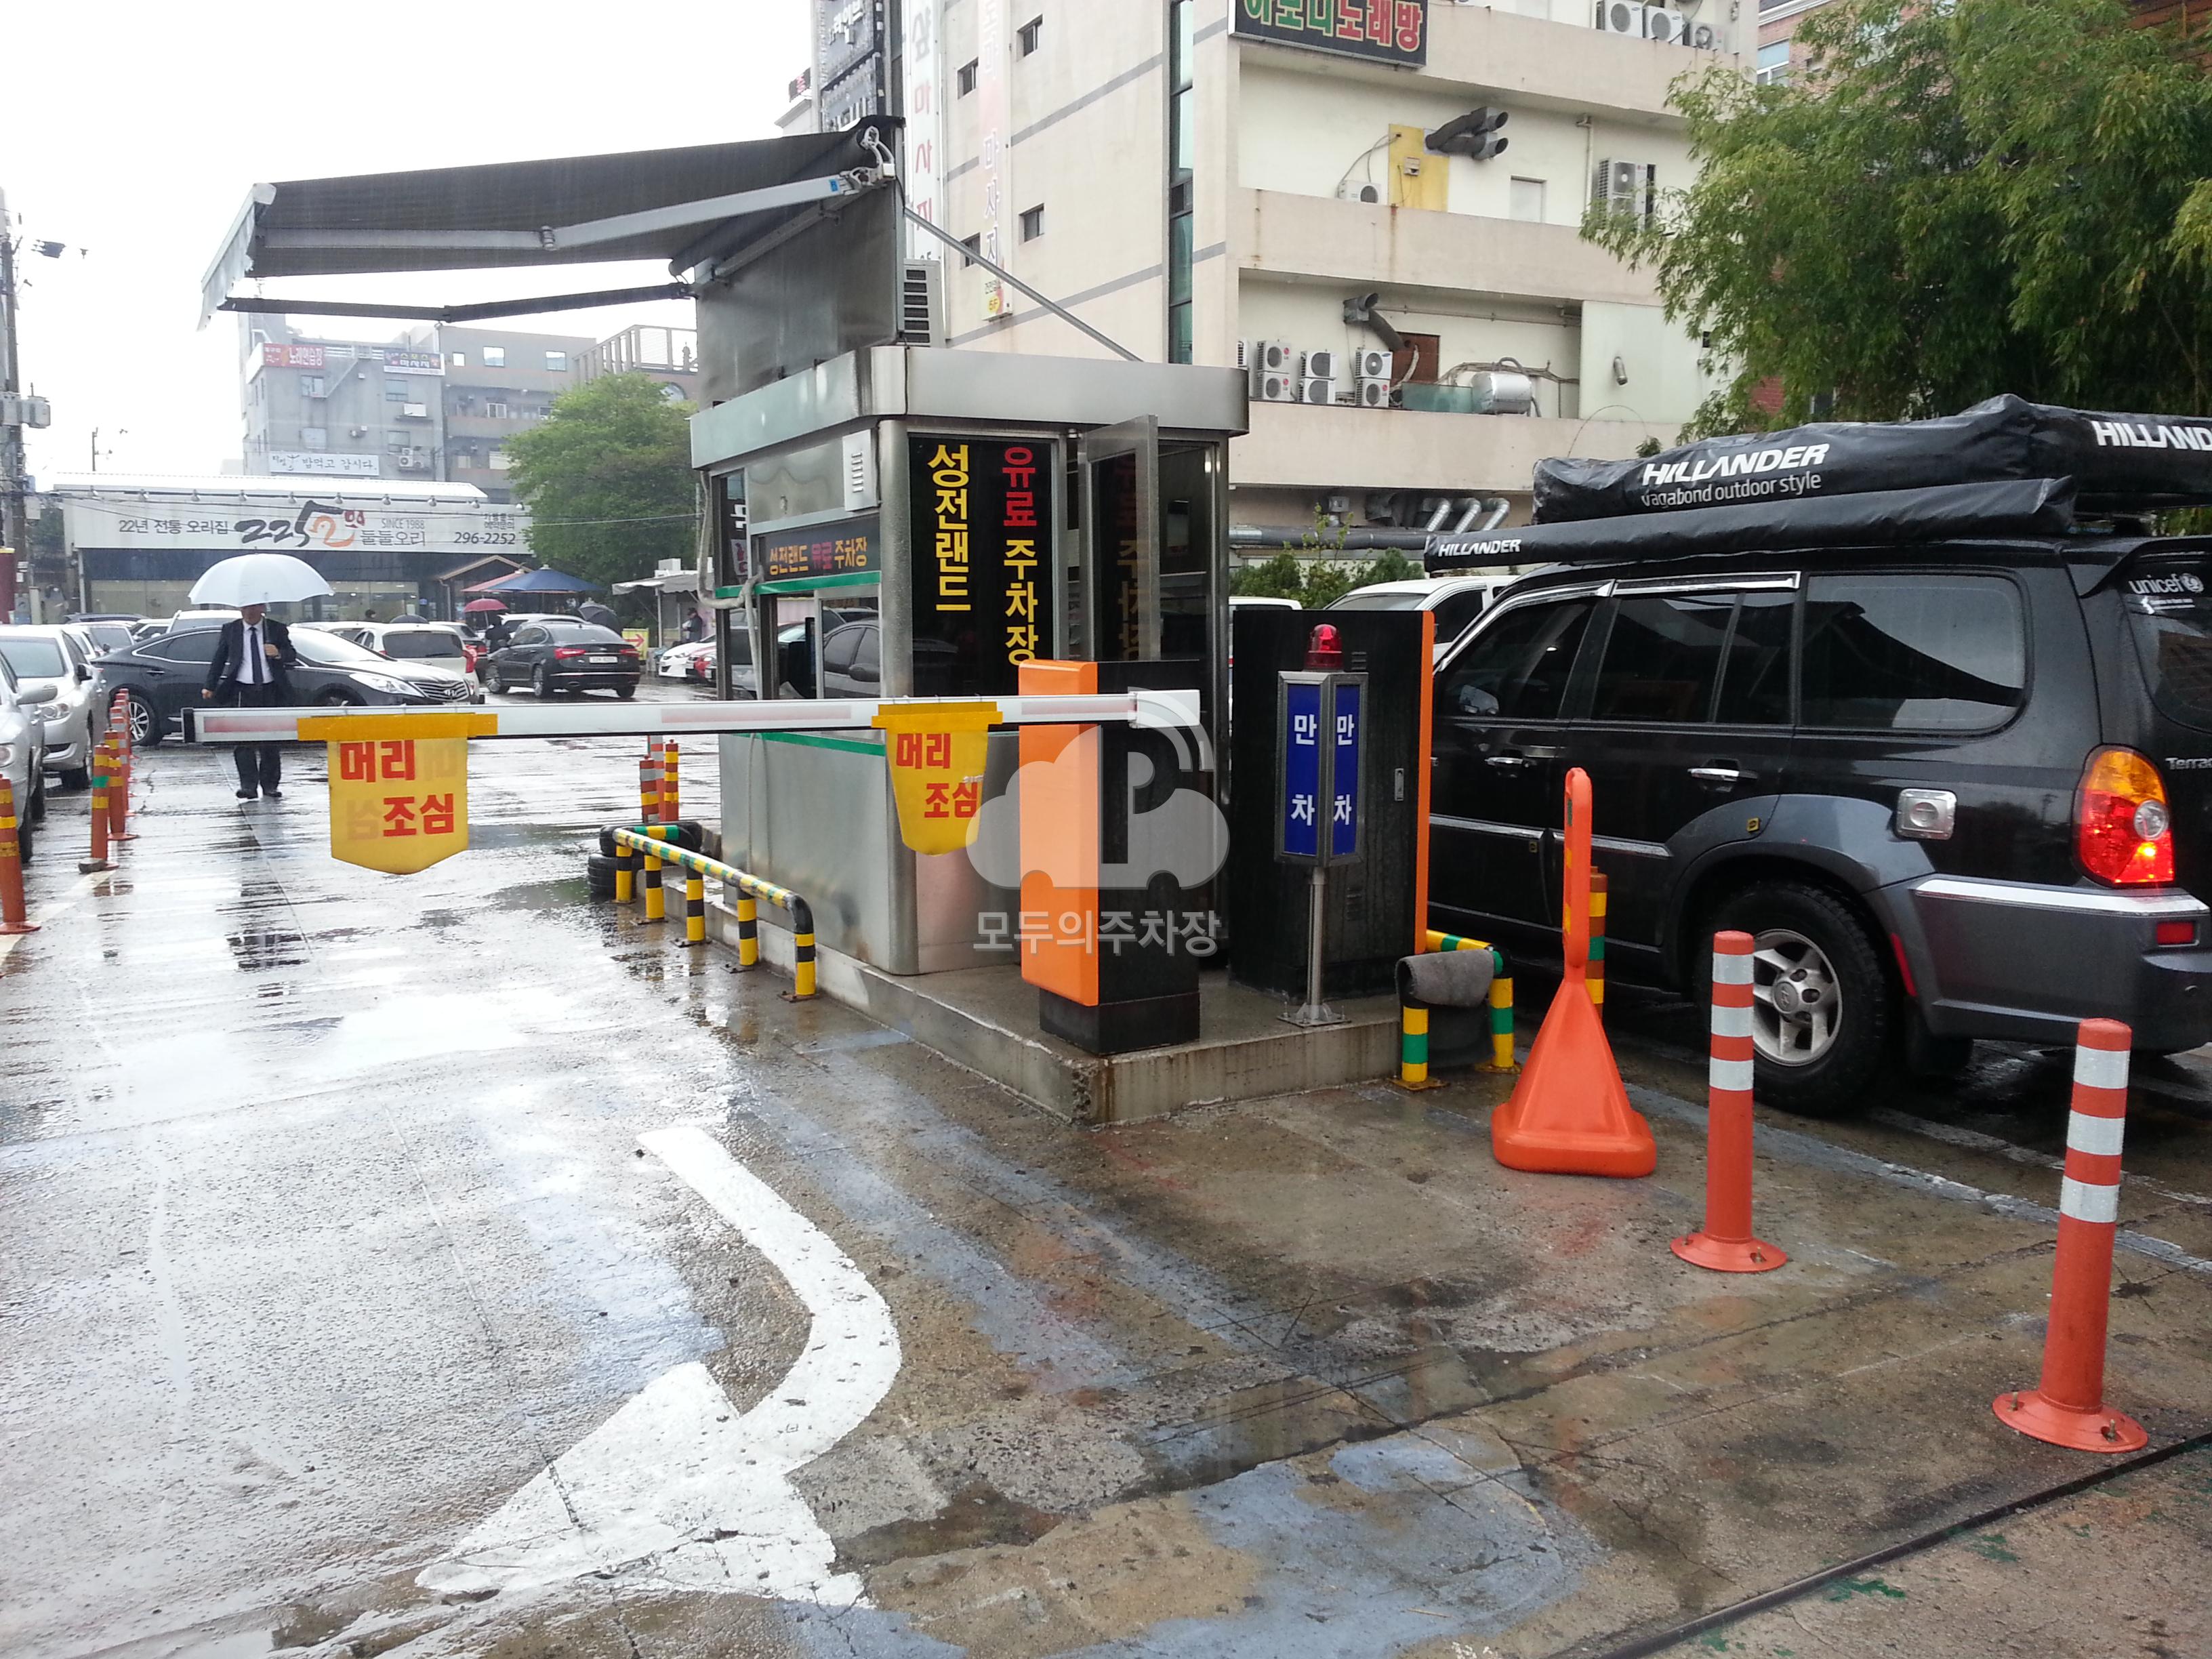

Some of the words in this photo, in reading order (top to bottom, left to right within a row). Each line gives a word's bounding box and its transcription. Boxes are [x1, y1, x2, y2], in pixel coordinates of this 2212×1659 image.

[2090, 420, 2212, 451] HILLAND
[302, 457, 335, 469] 밥먹고
[1641, 443, 1830, 487] HILLANDER
[1002, 447, 1038, 527] 유료
[1641, 483, 1713, 508] vagabond
[1714, 478, 1778, 501] outdoor
[1779, 470, 1822, 496] style
[119, 519, 149, 533] 22년
[154, 519, 182, 534] 전통
[187, 520, 228, 535] 오리집
[359, 529, 426, 546] 둘둘오리
[381, 517, 404, 529] SINCE
[406, 518, 425, 530] 1988
[454, 531, 516, 545] 296-2252
[927, 444, 971, 611] 성전랜드
[770, 545, 808, 575] 성전랜드
[811, 541, 833, 570] 유료
[834, 536, 868, 569] 주차장
[1437, 539, 1522, 557] HILLANDER
[2128, 573, 2184, 594] unicef
[1004, 539, 1039, 666] 주차장
[340, 739, 415, 783] 머리
[896, 733, 951, 769] 머리
[1290, 714, 1317, 826] 만차
[383, 794, 455, 838] 조심
[924, 781, 978, 818] 조심
